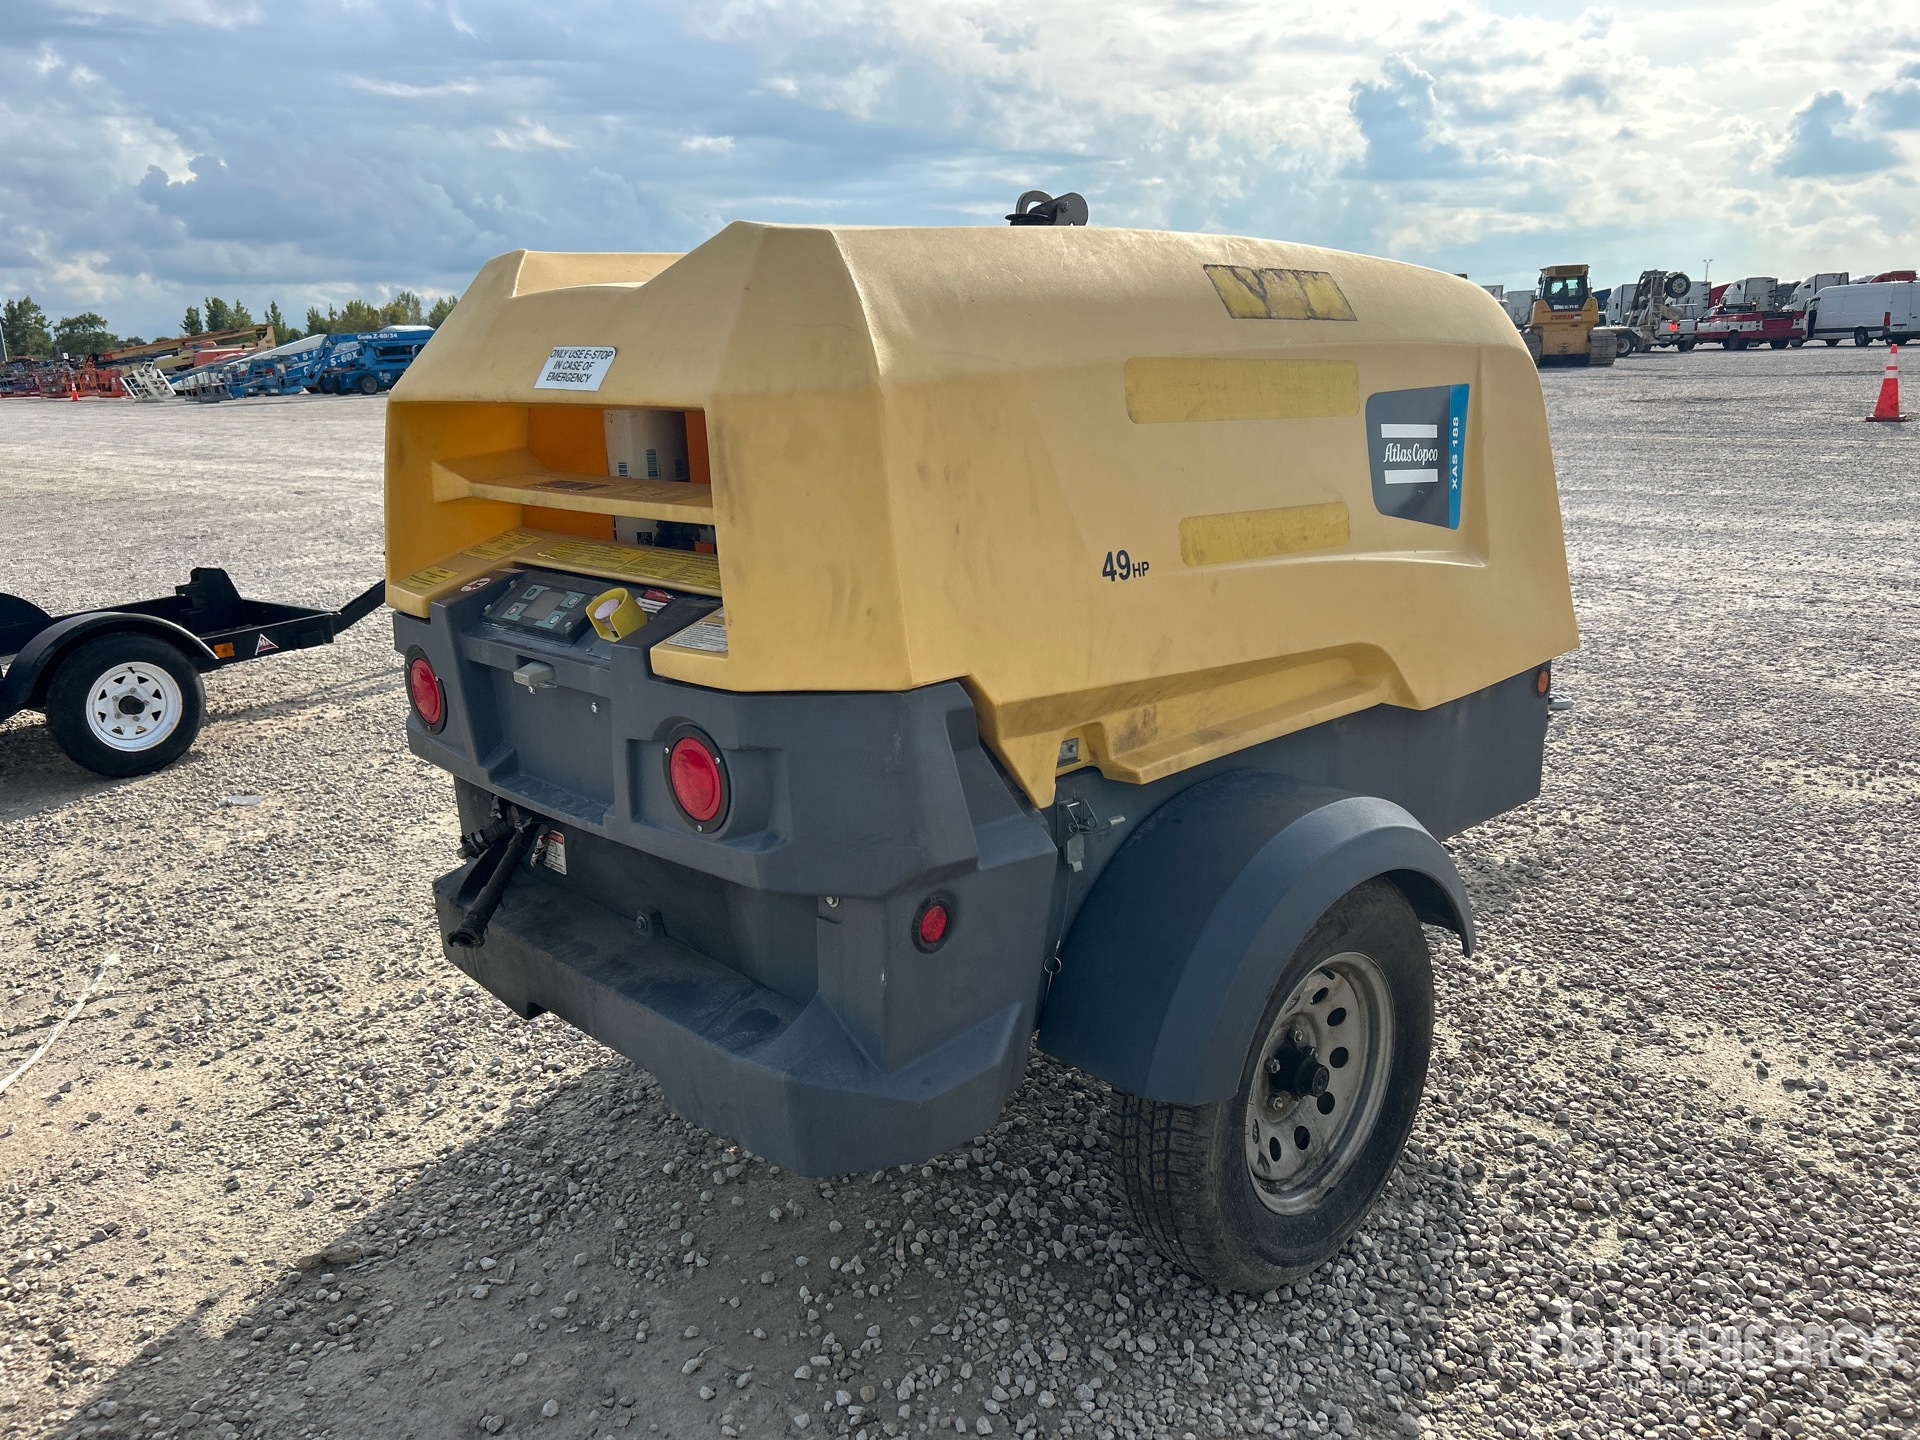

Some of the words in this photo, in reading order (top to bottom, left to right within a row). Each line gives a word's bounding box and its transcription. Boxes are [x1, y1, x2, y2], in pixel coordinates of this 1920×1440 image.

[330, 350, 358, 367] S-60X
[550, 349, 571, 358] ONLY
[568, 349, 585, 359] USE
[584, 350, 613, 360] E-STOP
[553, 361, 563, 370] IN
[562, 361, 583, 371] CASE
[582, 361, 595, 371] OF
[546, 372, 592, 383] EMERGENCY
[1383, 443, 1412, 463] Atlas
[1412, 443, 1438, 466] Copco
[1451, 454, 1459, 490] XAS
[1102, 549, 1131, 582] 49
[1132, 561, 1150, 579] HP
